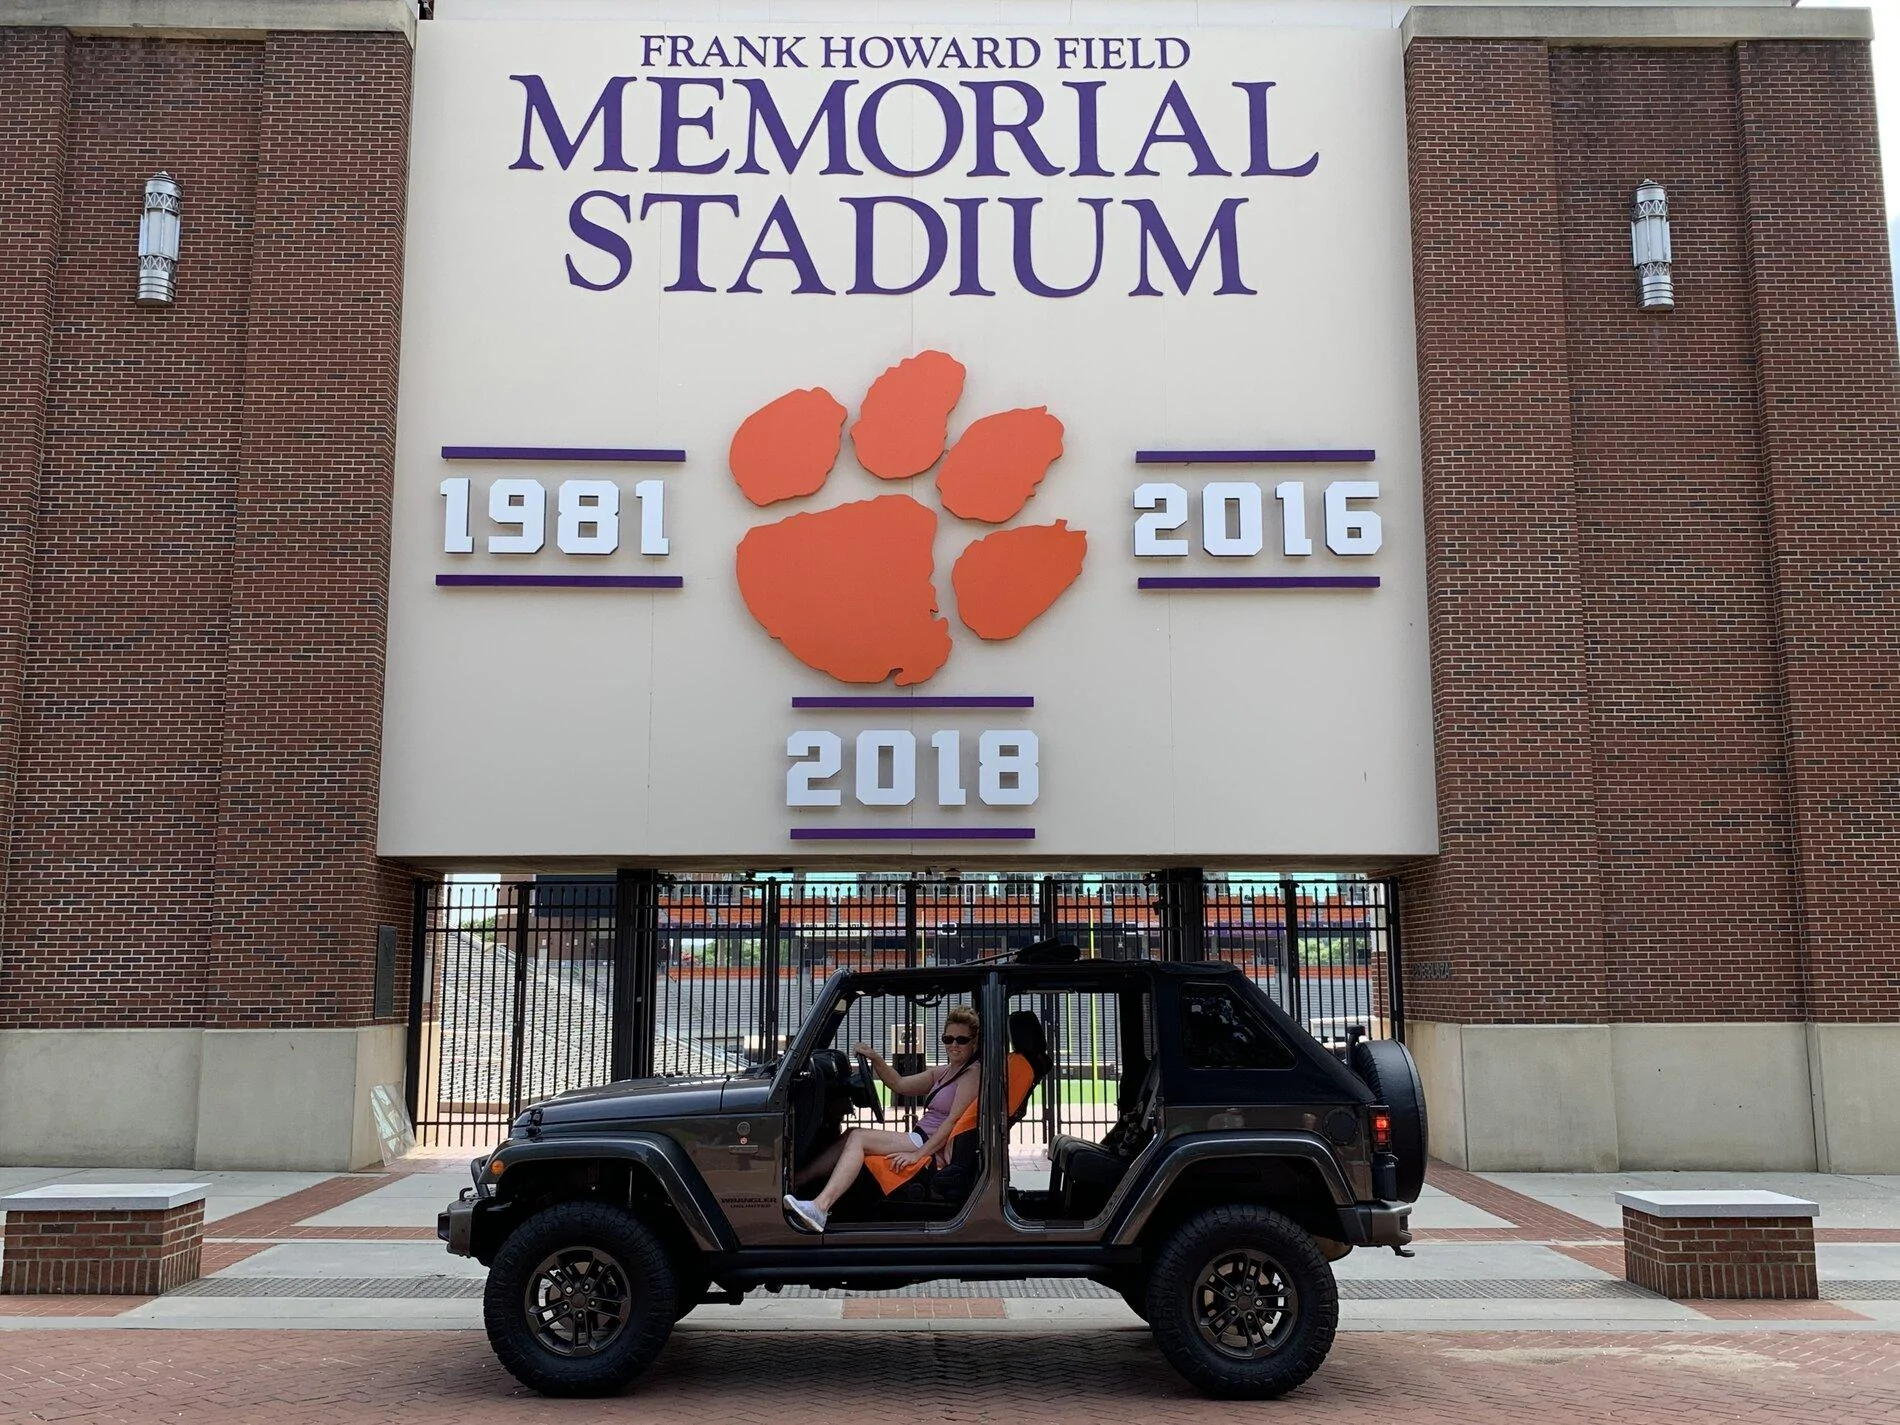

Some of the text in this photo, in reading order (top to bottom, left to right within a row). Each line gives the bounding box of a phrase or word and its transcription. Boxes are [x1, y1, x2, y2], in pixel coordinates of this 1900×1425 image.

[640, 35, 1191, 69] FRANK HOWARD FIELD
[508, 75, 1319, 178] MEMORIAL
[565, 189, 1258, 298] STADIUM
[440, 478, 670, 556] 1981
[1133, 481, 1383, 557] 2016
[786, 729, 1040, 806] 2018
